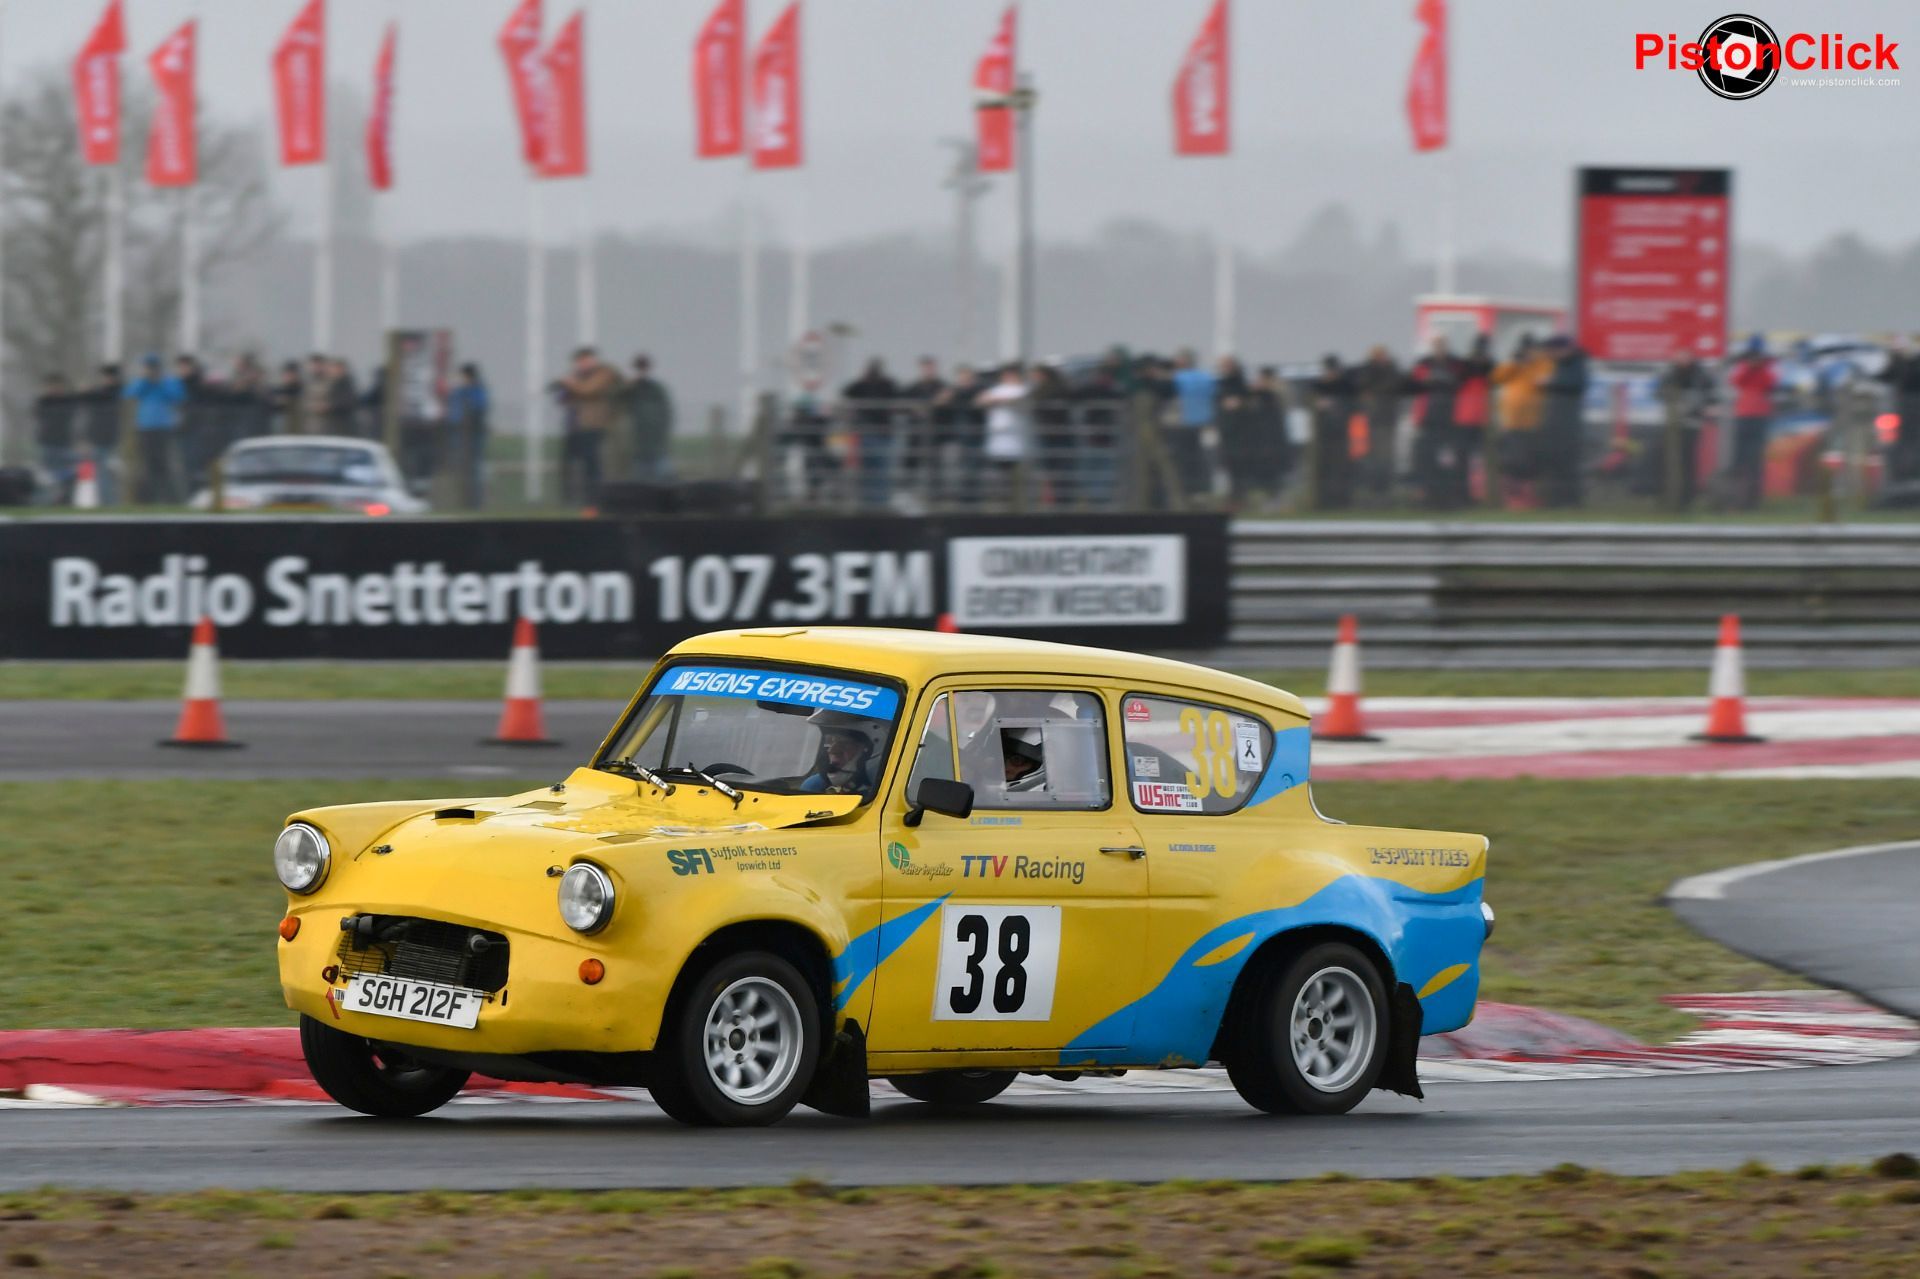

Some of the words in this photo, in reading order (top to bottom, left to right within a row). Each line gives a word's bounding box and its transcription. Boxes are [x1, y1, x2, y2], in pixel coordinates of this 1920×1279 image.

[50, 553, 254, 626] Radio
[264, 556, 632, 625] Snetterton
[649, 551, 932, 621] 107.3FM
[687, 672, 761, 694] SIGNS
[758, 678, 880, 710] EXPRESS
[1180, 708, 1236, 798] 38
[667, 848, 715, 876] SFI
[710, 846, 747, 860] Suffolk
[748, 846, 797, 856] Fasteners
[737, 860, 767, 872] Ipswich
[768, 861, 781, 870] Ltd
[961, 855, 1008, 877] TTV
[1014, 855, 1085, 884] Racing
[950, 914, 1030, 1013] 38
[359, 979, 407, 1013] SGH
[409, 987, 467, 1019] 212F
